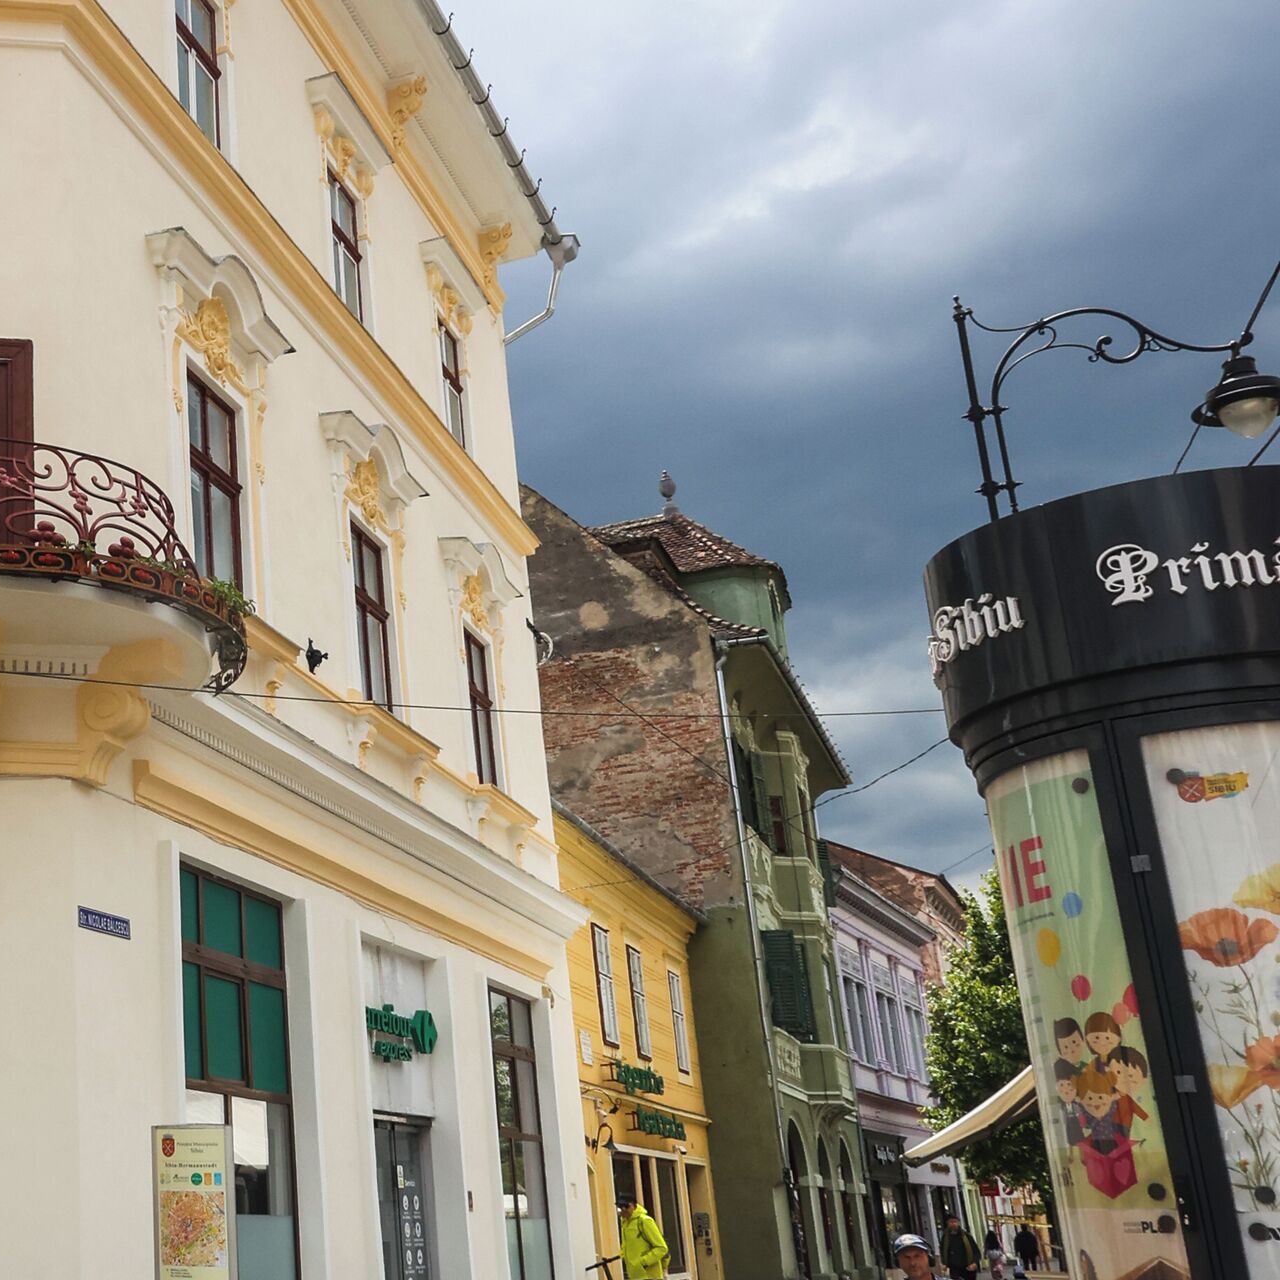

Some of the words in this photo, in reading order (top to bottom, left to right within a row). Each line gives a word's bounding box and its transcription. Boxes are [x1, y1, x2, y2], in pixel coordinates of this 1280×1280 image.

[1096, 536, 1280, 606] Prim
[934, 593, 1024, 663] Sibiu
[88, 913, 107, 930] NICOLAE
[365, 1004, 412, 1037] arrefour
[375, 1040, 412, 1063] express
